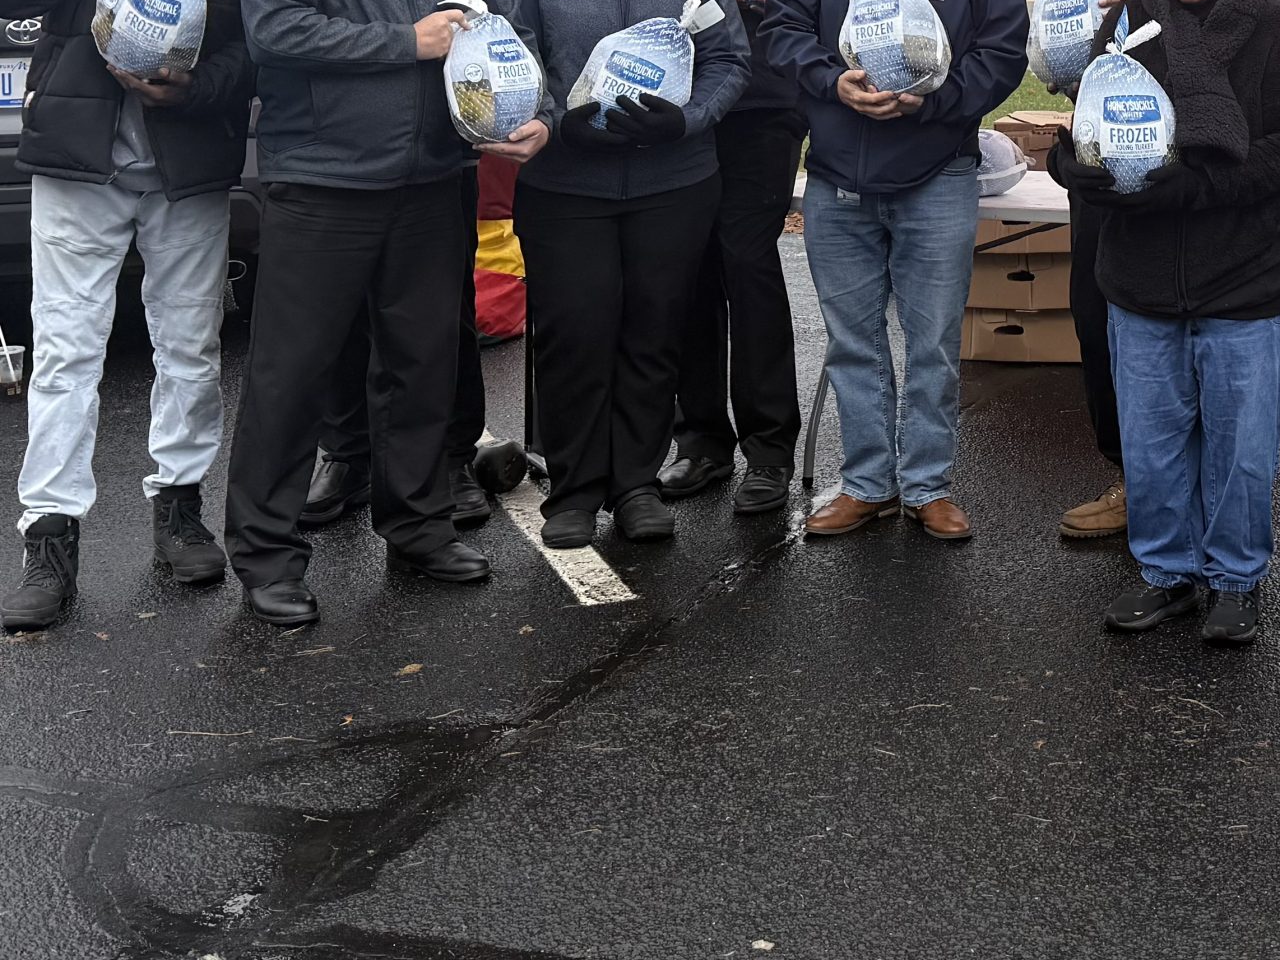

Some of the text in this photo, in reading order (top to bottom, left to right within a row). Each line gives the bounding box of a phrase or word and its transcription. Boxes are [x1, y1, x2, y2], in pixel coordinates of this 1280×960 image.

[125, 11, 169, 41] FROZEN
[856, 21, 894, 40] FROZEN
[1045, 18, 1084, 36] FROZEN
[497, 62, 532, 79] FROZEN
[611, 52, 662, 81] HONEYSUCKLE
[1107, 100, 1155, 112] HONEYSUCKLE
[1110, 127, 1158, 143] FROZEN
